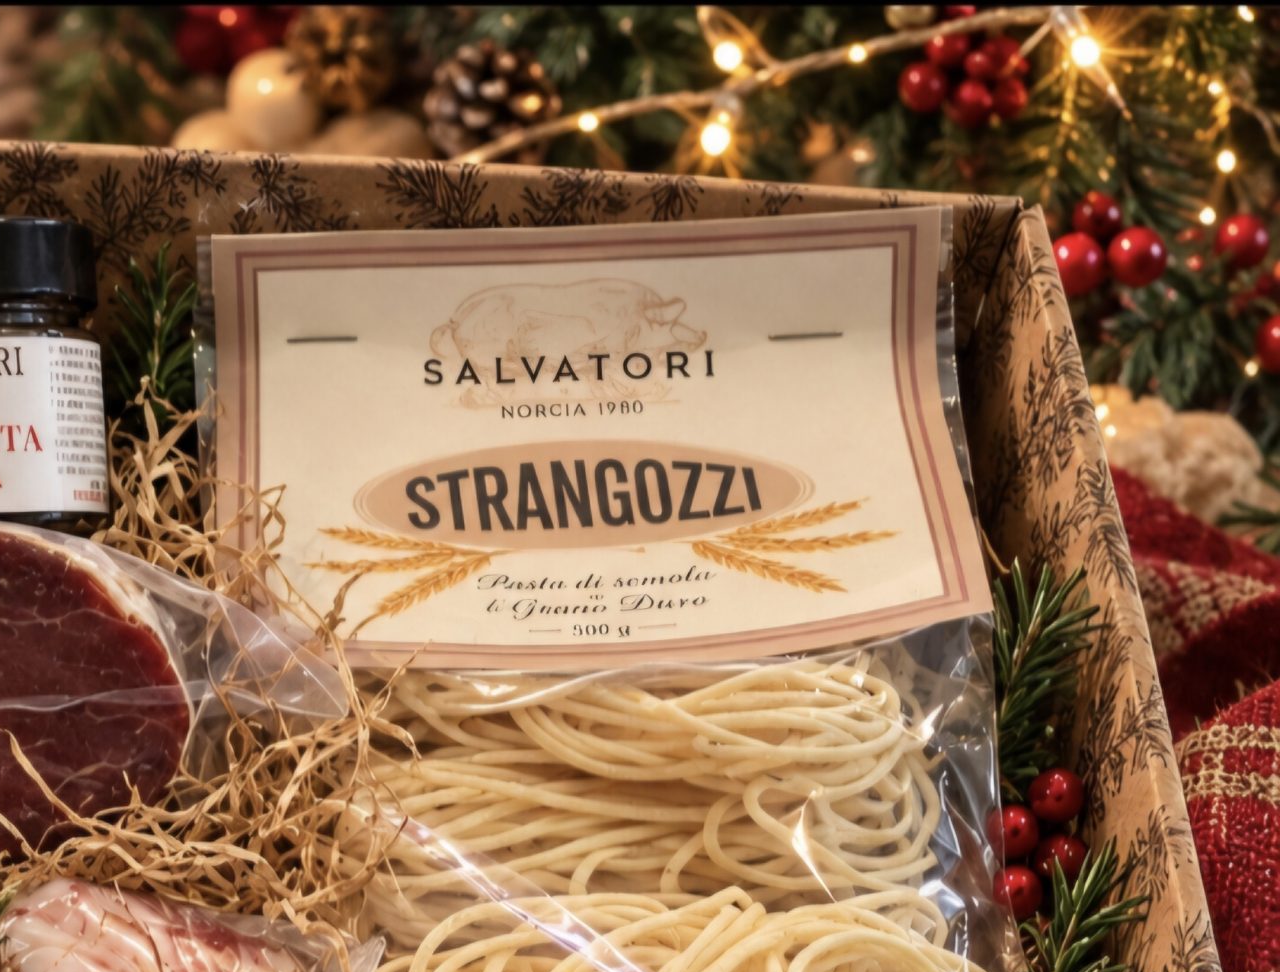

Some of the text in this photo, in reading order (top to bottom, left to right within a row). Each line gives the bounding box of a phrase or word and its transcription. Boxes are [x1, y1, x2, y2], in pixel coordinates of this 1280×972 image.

[423, 349, 716, 387] SALVATORI
[500, 399, 644, 420] NORCIA 1980
[404, 457, 764, 533] STRANGOZZI
